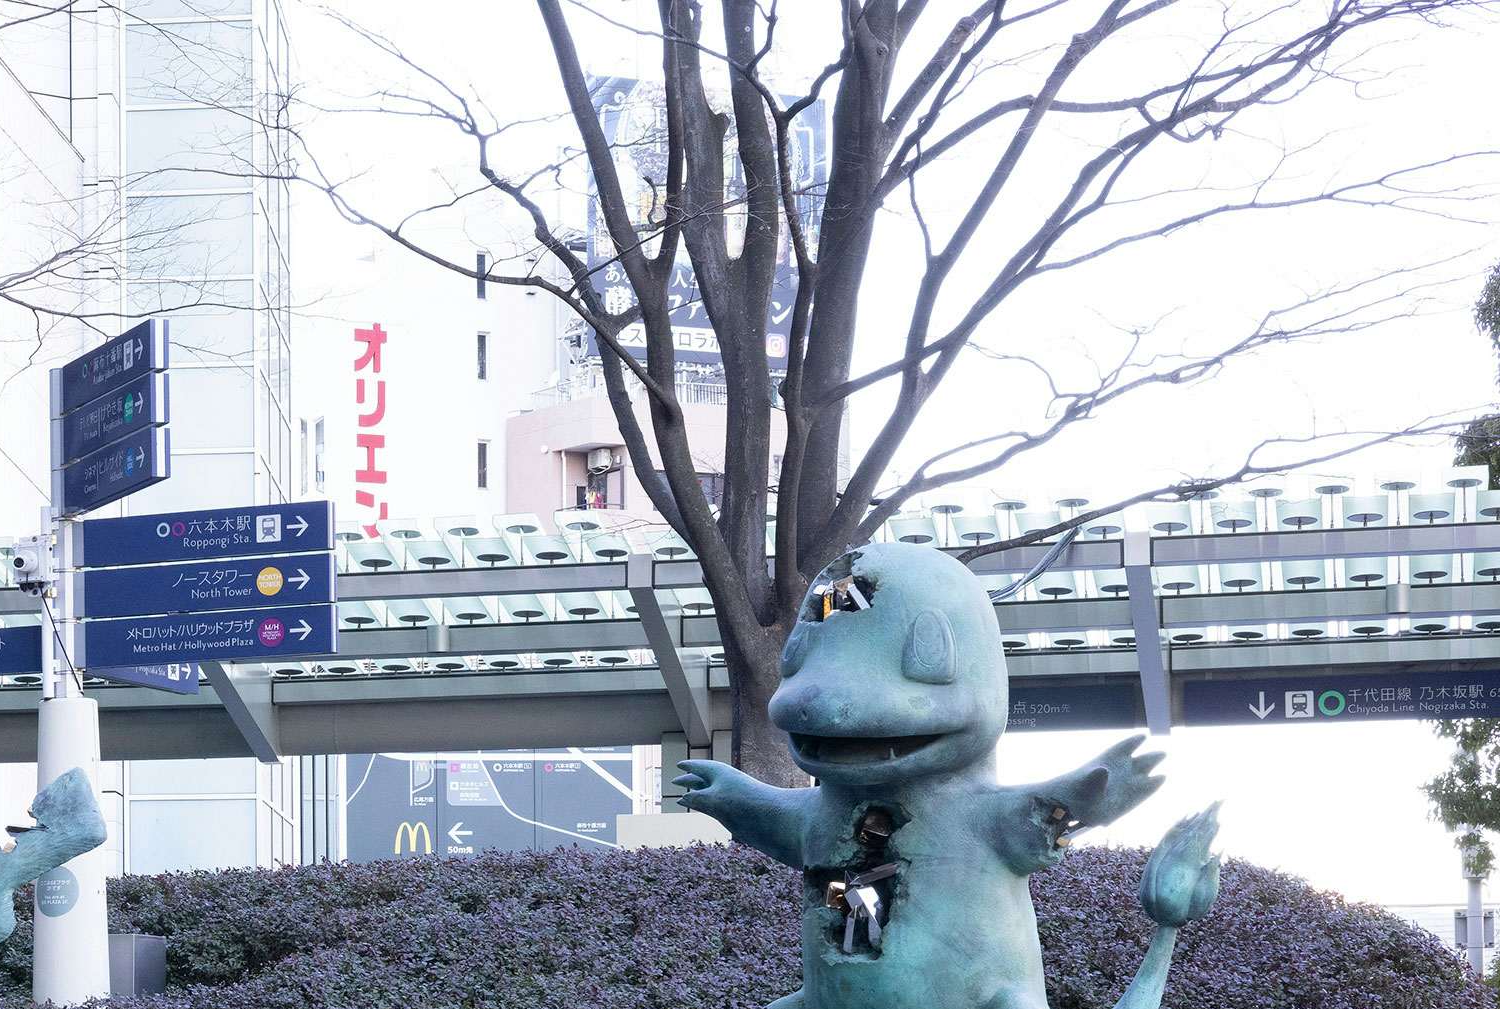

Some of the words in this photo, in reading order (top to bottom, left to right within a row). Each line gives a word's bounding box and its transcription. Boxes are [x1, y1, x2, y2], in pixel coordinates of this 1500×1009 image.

[188, 515, 251, 535] 六本木駅
[183, 534, 230, 549] Roppongi
[233, 534, 252, 544] Sta.
[171, 569, 253, 588] ノースタワー
[191, 588, 221, 599] North
[223, 586, 253, 598] Tower
[133, 642, 160, 654] Metro
[161, 641, 177, 652] Hat
[184, 638, 231, 652] Hollywood
[232, 637, 254, 647] Plaza
[1348, 687, 1412, 702] 千代田線
[1419, 684, 1484, 699] 乃木坂駅
[1348, 703, 1389, 715] Chiyoda
[1392, 703, 1414, 712] Line
[1419, 701, 1466, 713] Nogizaka
[1469, 699, 1489, 710] Sta.
